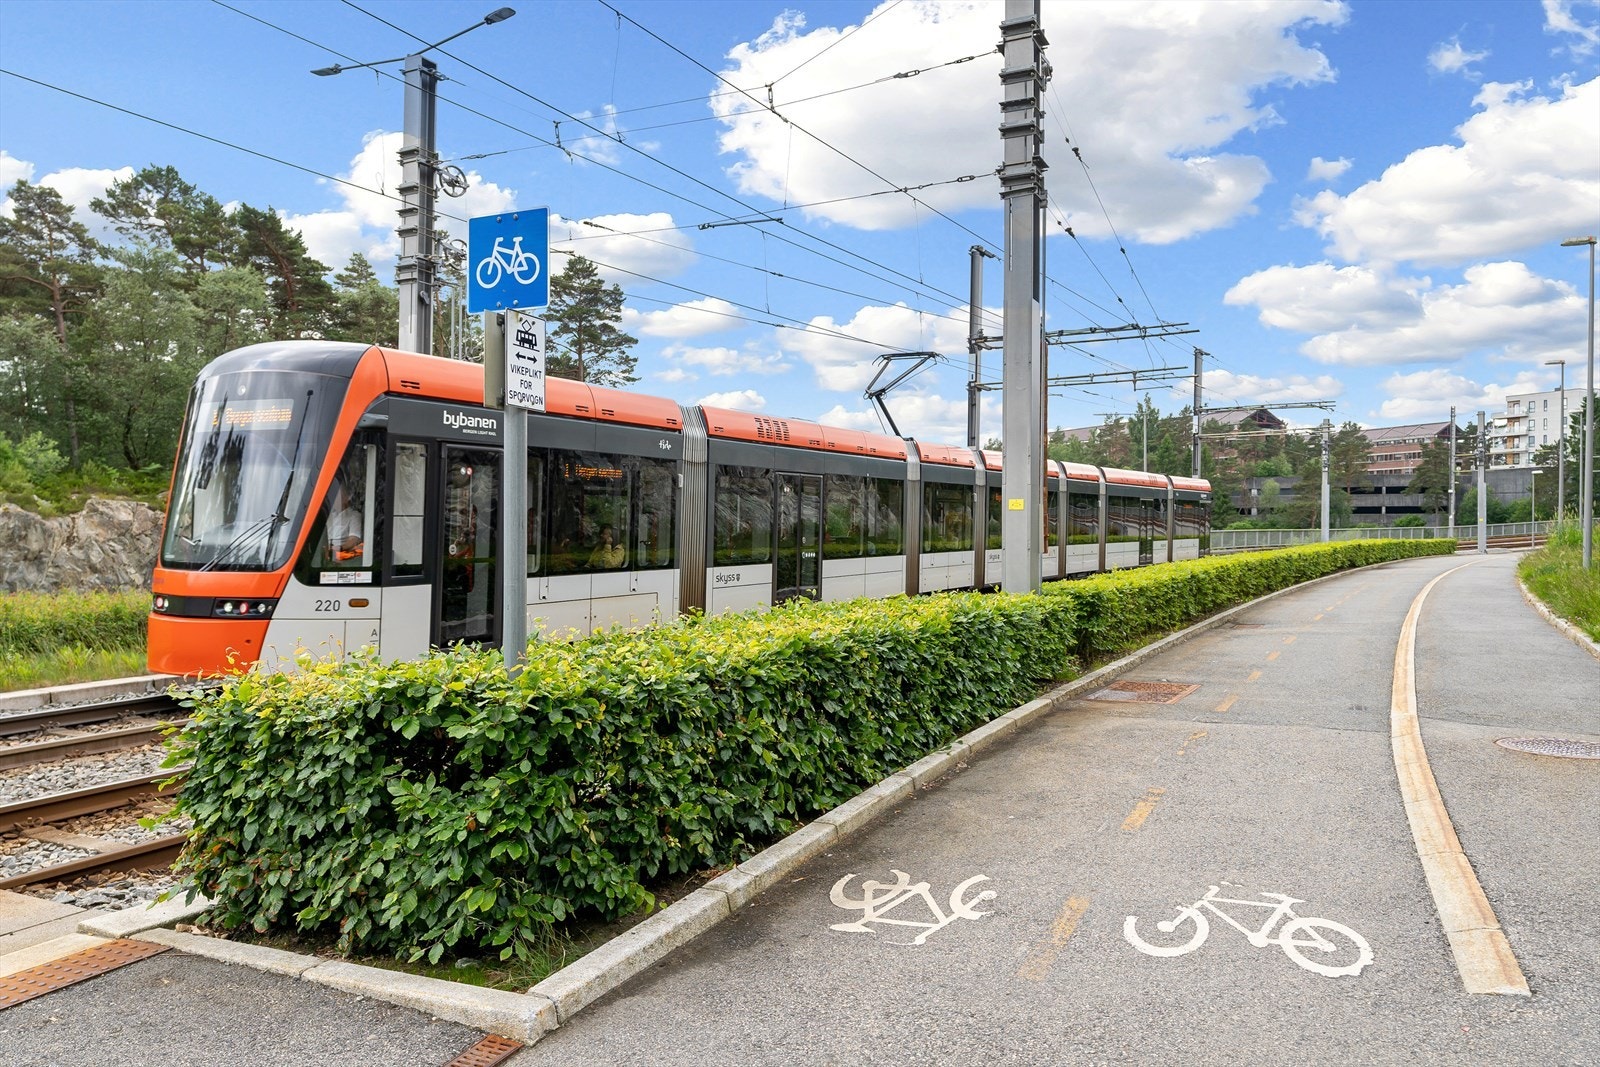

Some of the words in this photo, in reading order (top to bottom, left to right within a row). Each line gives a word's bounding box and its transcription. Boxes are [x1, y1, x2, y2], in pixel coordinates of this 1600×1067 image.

[510, 363, 542, 380] VIKEPLIKT
[520, 379, 533, 391] FOR
[508, 389, 544, 405] SPORVOGN
[443, 410, 497, 429] bybanen
[715, 572, 736, 585] skyss
[314, 599, 341, 612] 220
[370, 628, 378, 637] A
